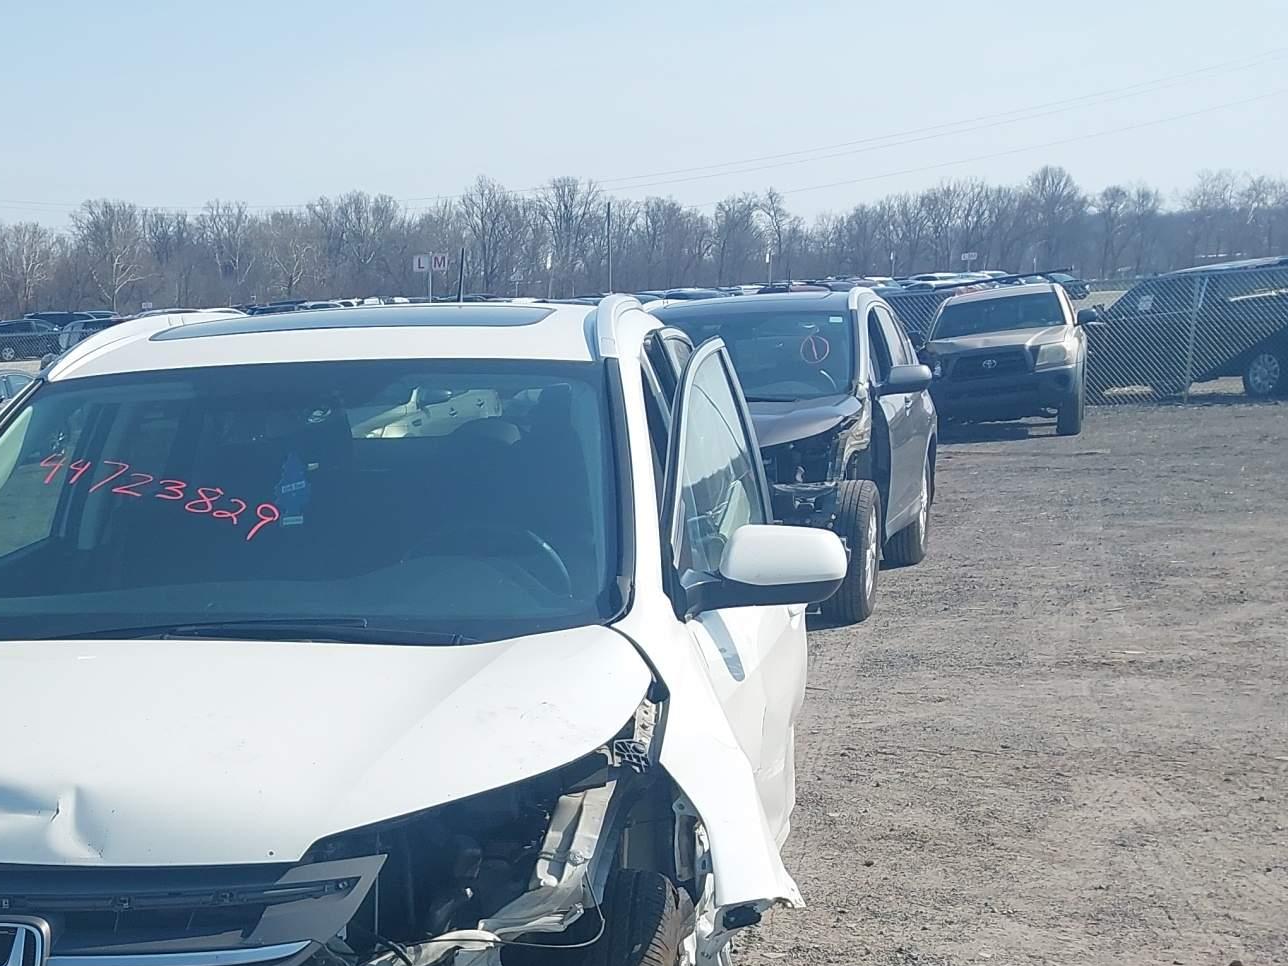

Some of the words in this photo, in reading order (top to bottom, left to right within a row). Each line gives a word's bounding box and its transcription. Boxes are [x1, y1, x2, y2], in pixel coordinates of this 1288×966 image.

[417, 257, 424, 269] L
[433, 256, 446, 268] M
[39, 453, 280, 541] 44723829
